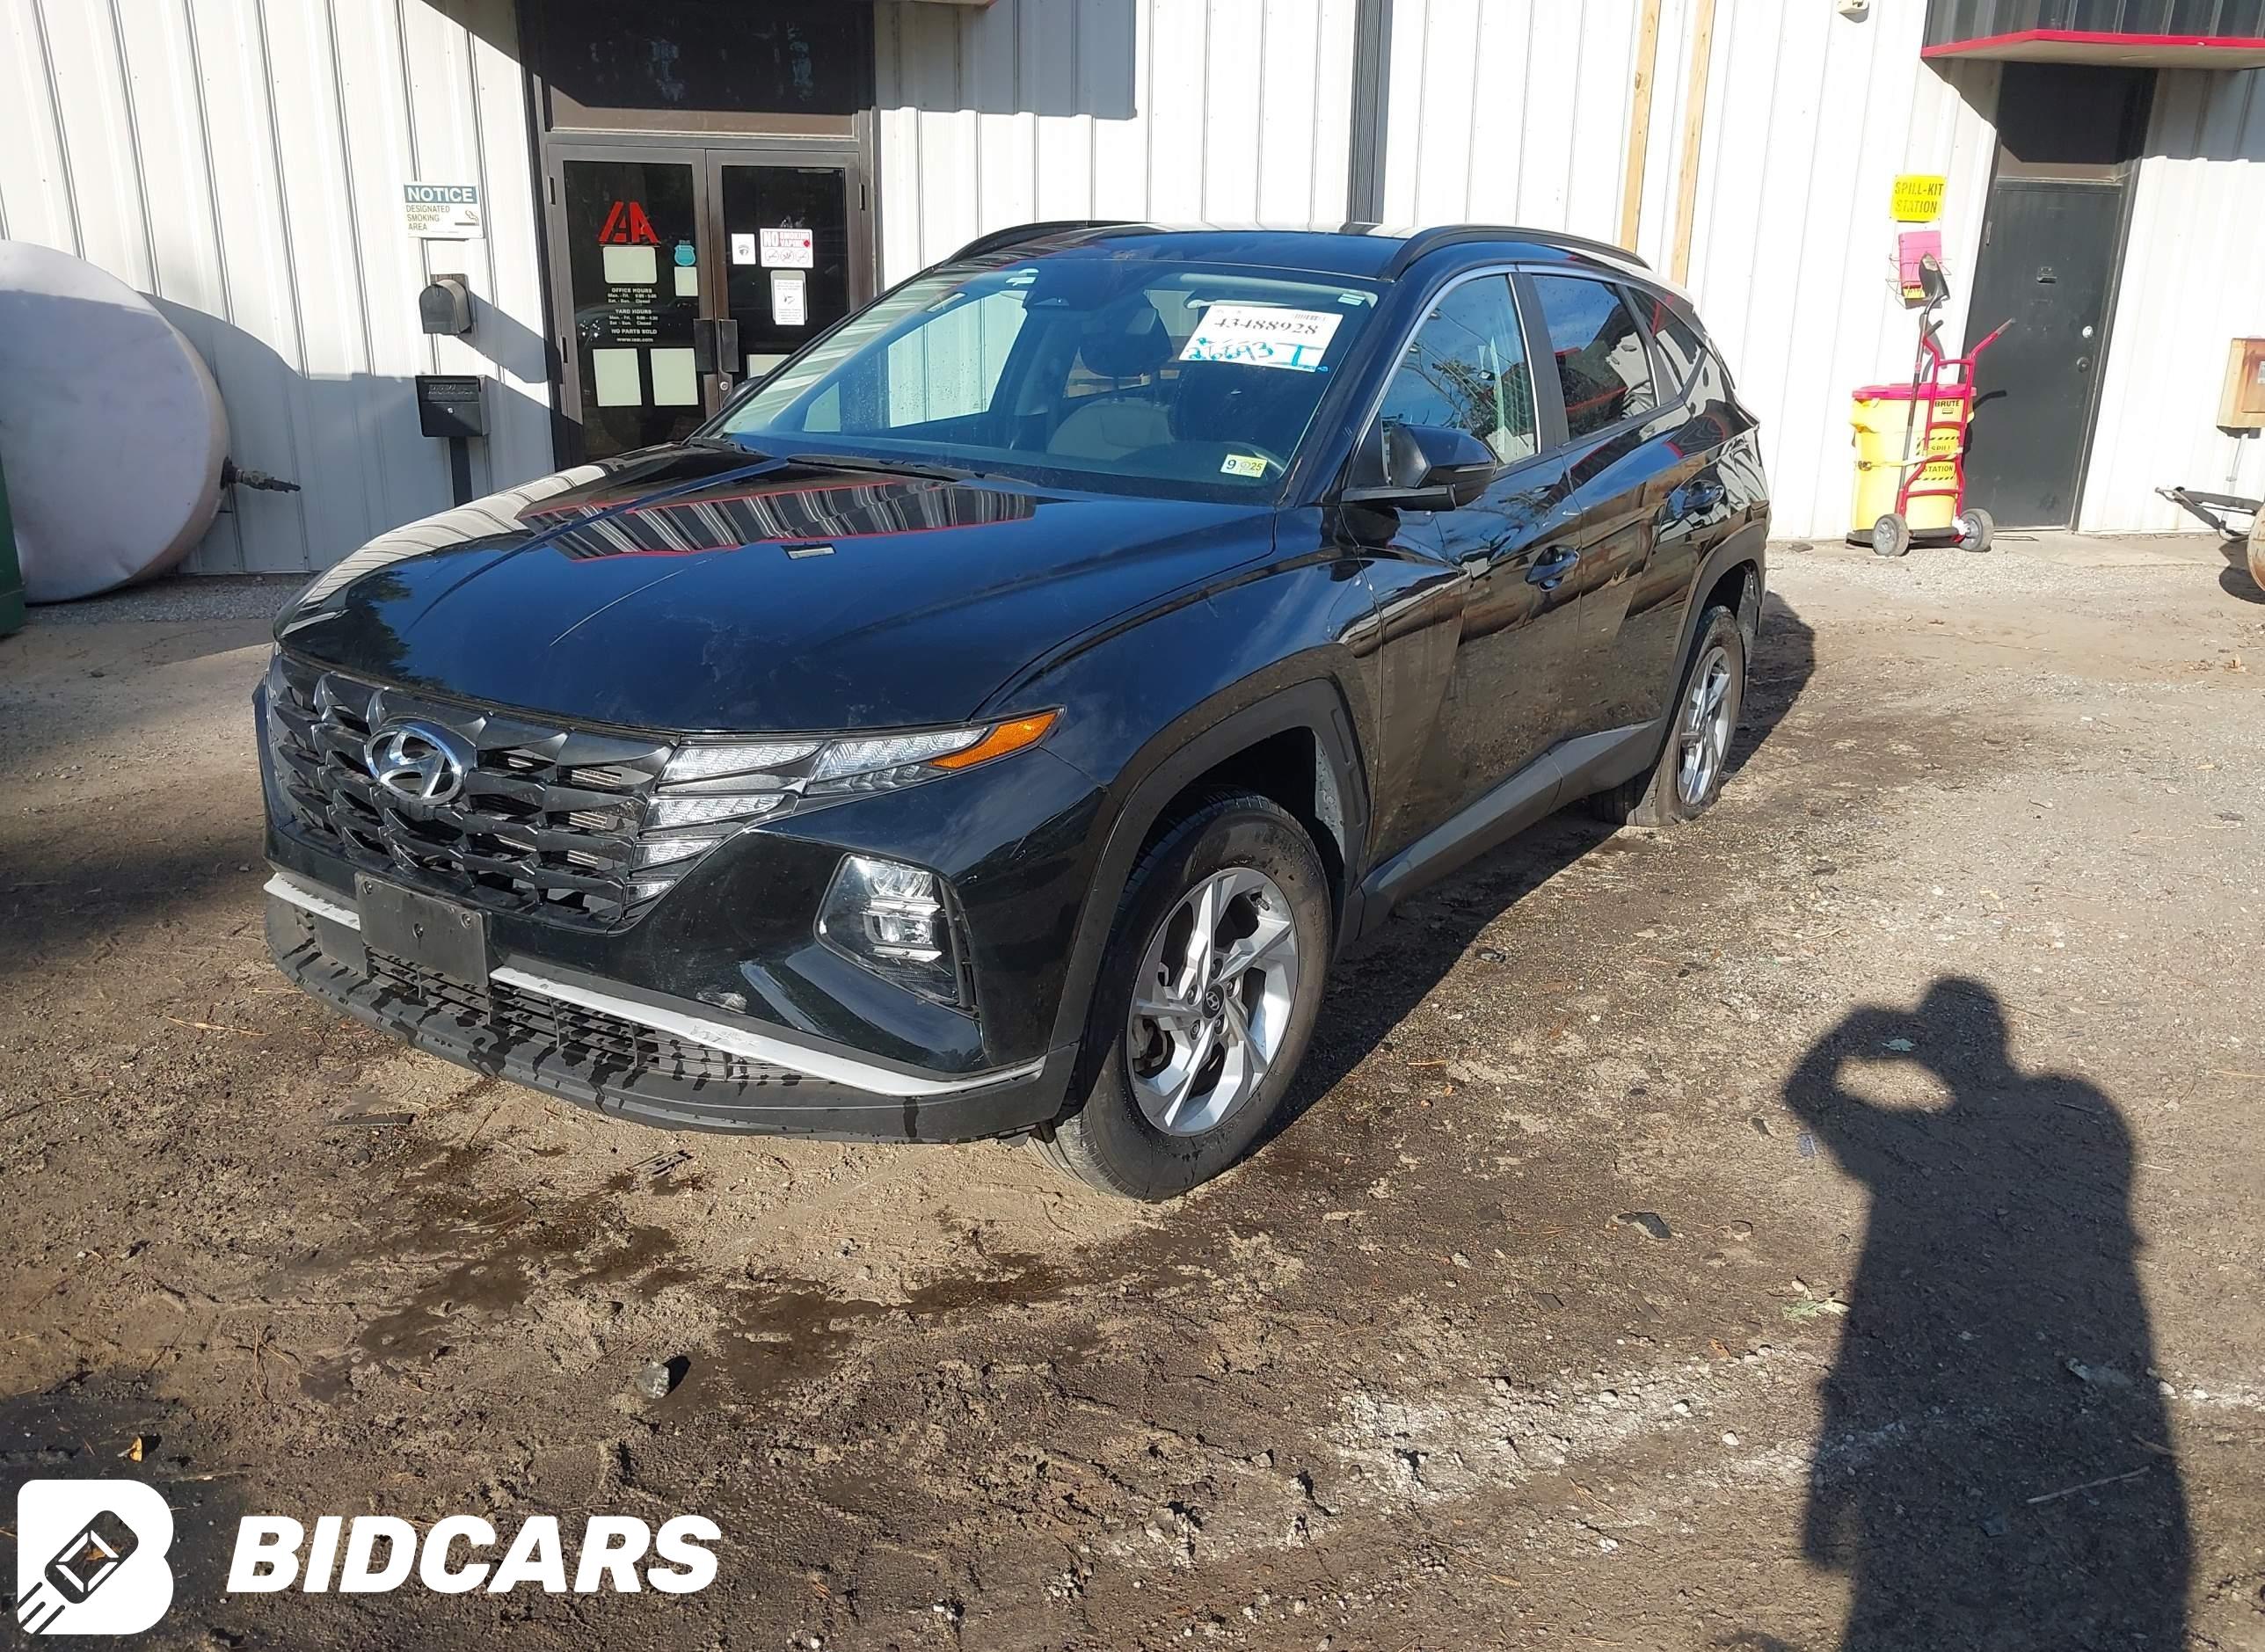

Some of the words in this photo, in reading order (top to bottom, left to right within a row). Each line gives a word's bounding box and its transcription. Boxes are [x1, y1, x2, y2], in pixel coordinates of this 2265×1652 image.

[407, 187, 474, 202] NOTICE
[1895, 181, 1944, 196] SPILL-KIT
[405, 204, 450, 213] DESIGNATED
[1895, 199, 1938, 213] STATION
[763, 231, 779, 247] NO
[1227, 459, 1236, 469] 9
[1249, 462, 1263, 471] 25
